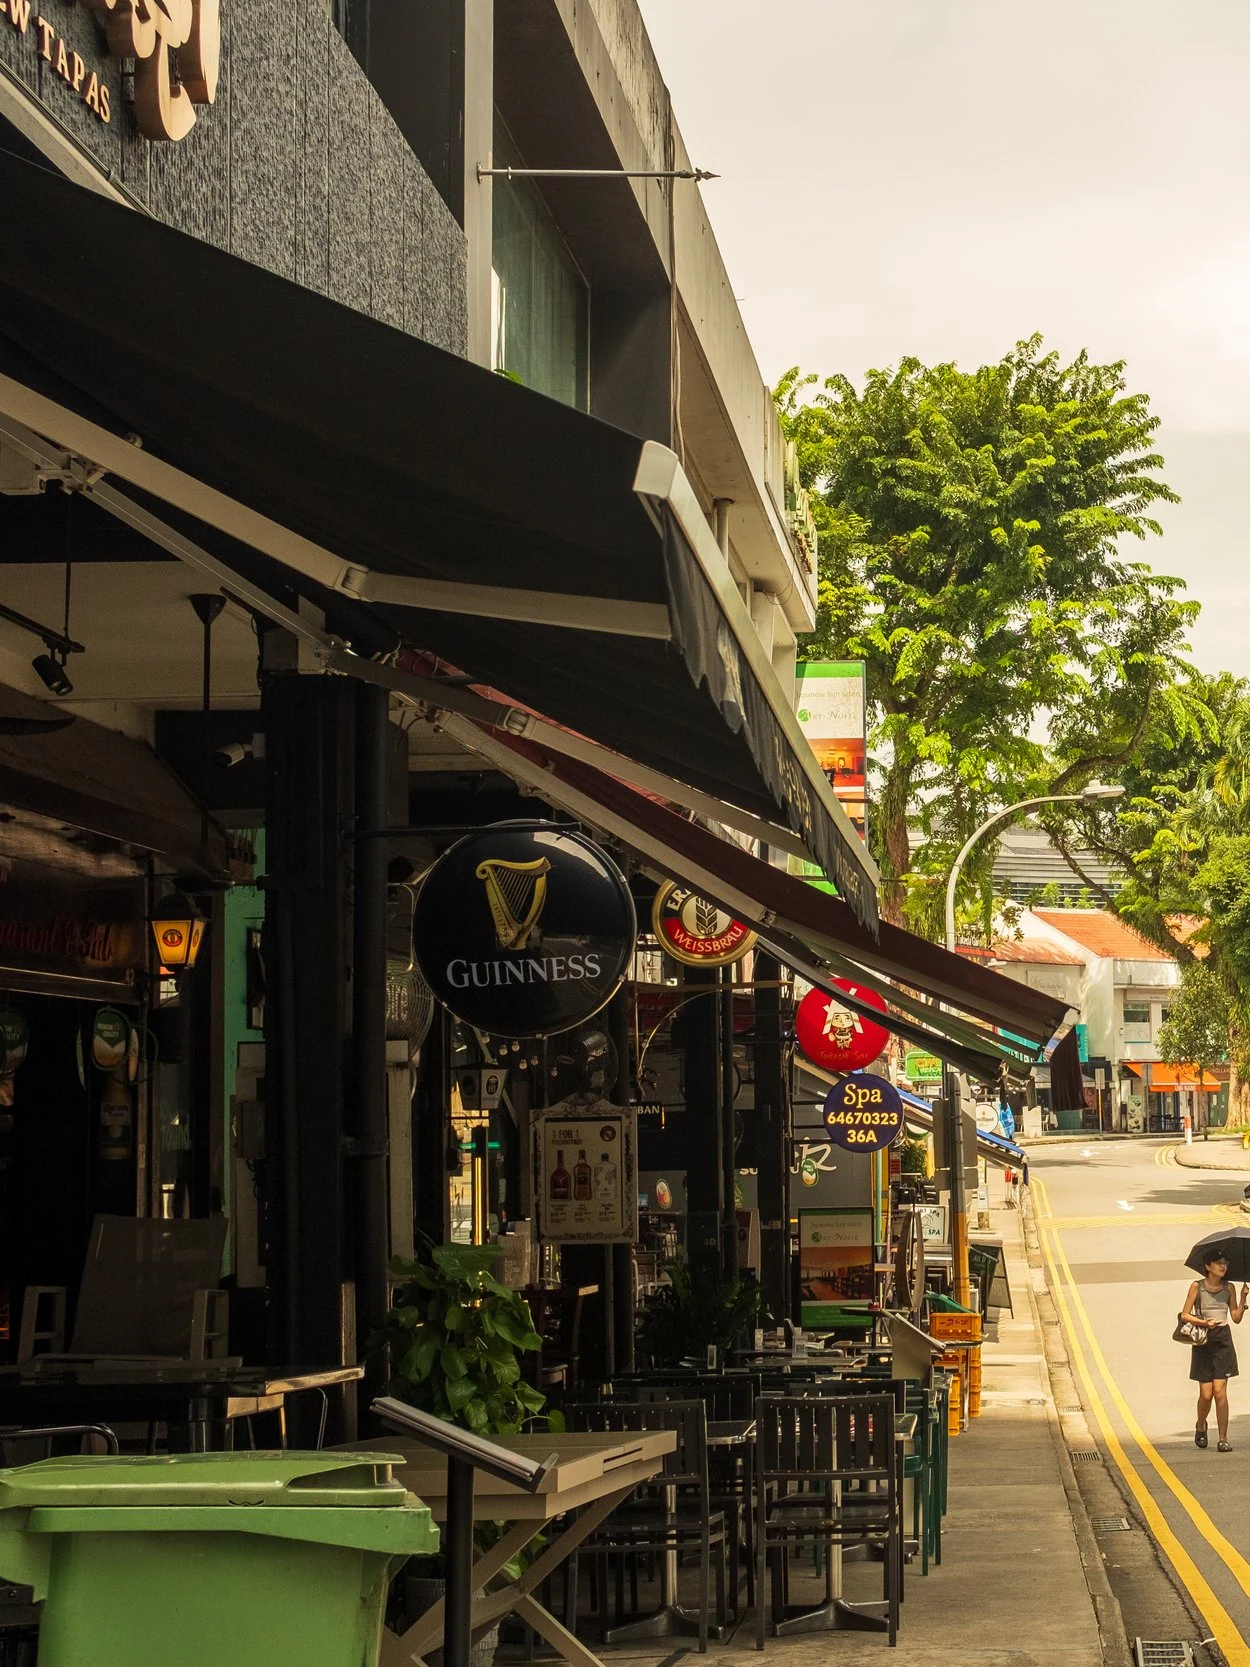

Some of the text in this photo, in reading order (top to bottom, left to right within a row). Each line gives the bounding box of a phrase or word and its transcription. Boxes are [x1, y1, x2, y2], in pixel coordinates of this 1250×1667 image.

[37, 15, 111, 124] TAPAS
[446, 953, 601, 989] GUINNESS
[843, 1083, 883, 1108] Spa
[637, 1104, 661, 1115] BAN
[827, 1111, 898, 1125] 64670323
[846, 1130, 878, 1143] 36A
[927, 1228, 941, 1236] SPA
[702, 1237, 717, 1246] 40
